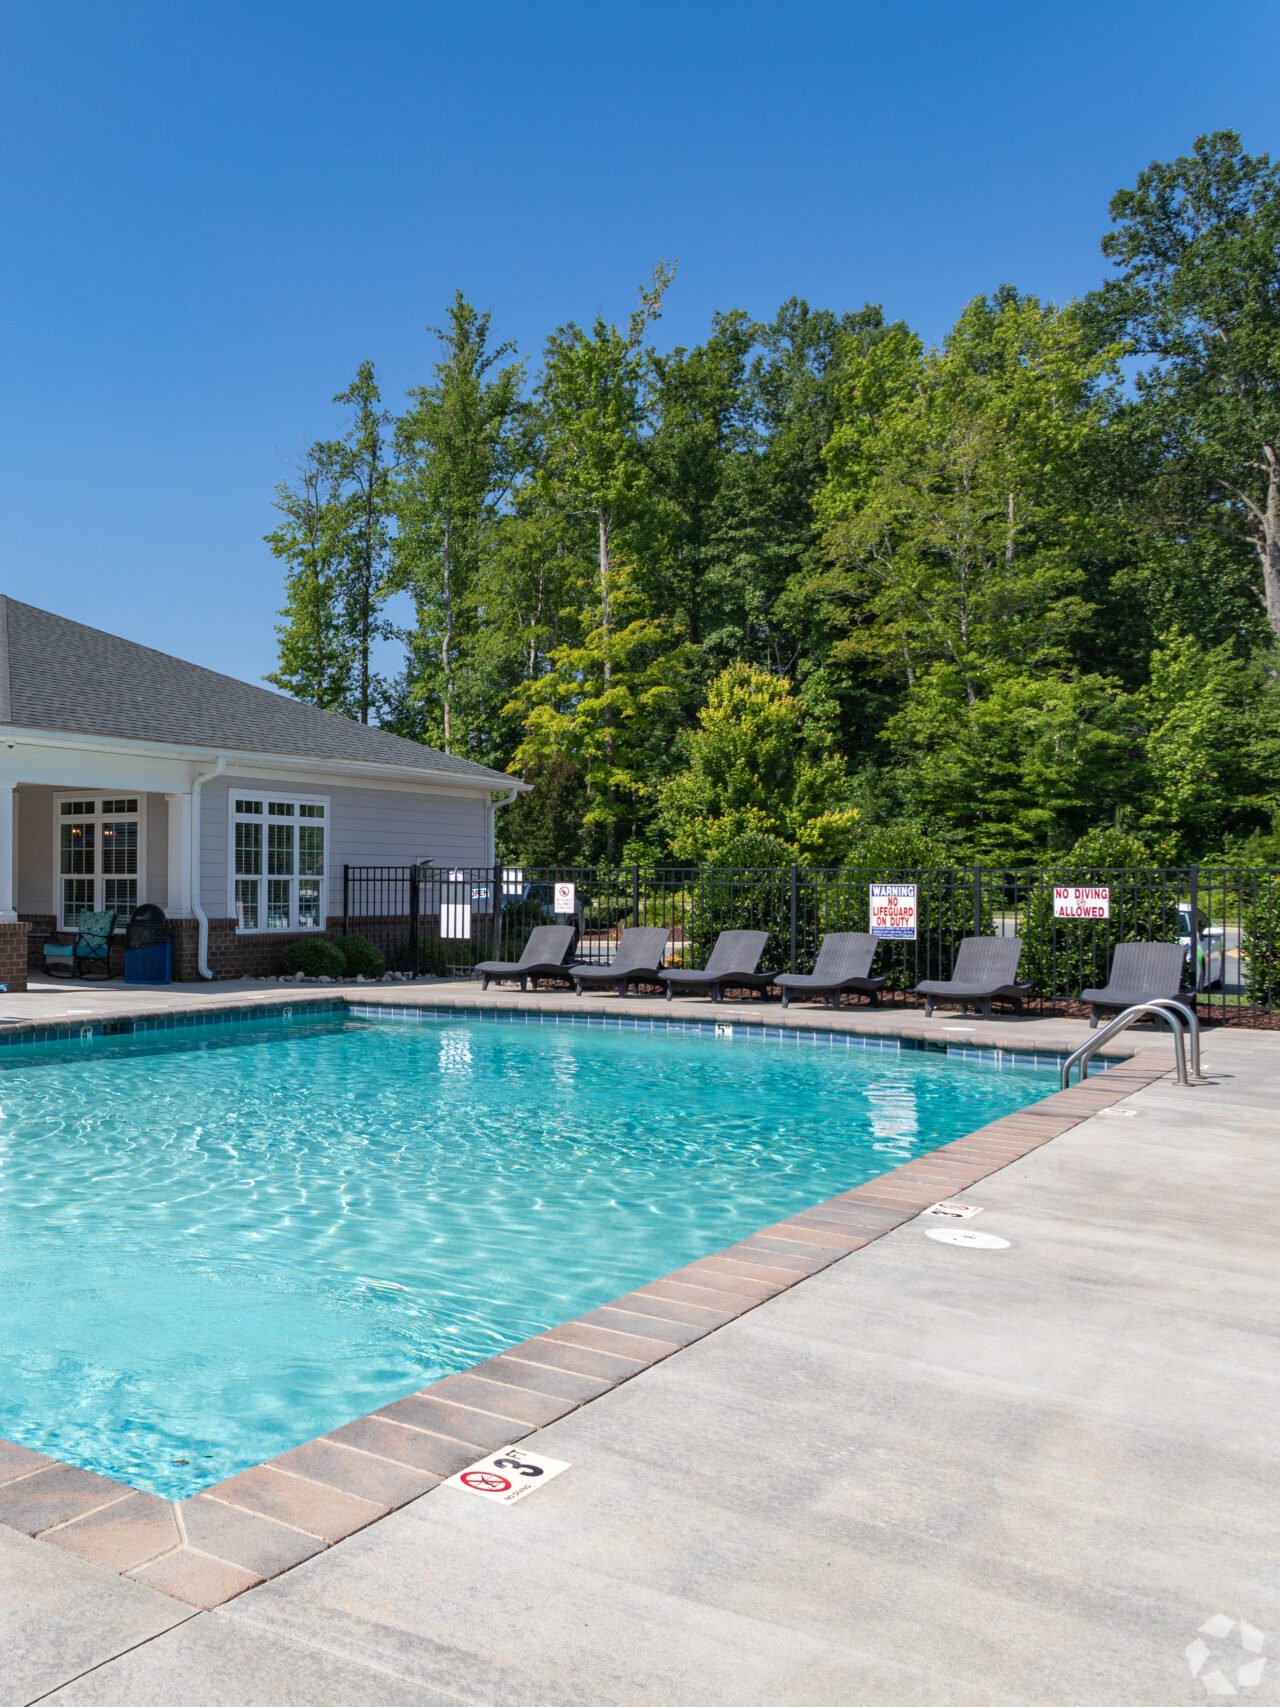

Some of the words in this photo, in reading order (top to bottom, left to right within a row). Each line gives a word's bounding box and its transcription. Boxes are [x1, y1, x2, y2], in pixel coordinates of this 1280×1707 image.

[872, 886, 914, 896] WARNING
[1055, 888, 1069, 899] NO
[1074, 888, 1108, 899] DIVING
[887, 897, 899, 906] NO
[872, 906, 914, 916] LIFEGUARD
[1058, 906, 1105, 917] ALLOWED
[876, 916, 887, 926] ON
[890, 916, 910, 926] DUTY
[505, 1449, 527, 1460] FT
[493, 1458, 544, 1477] 3
